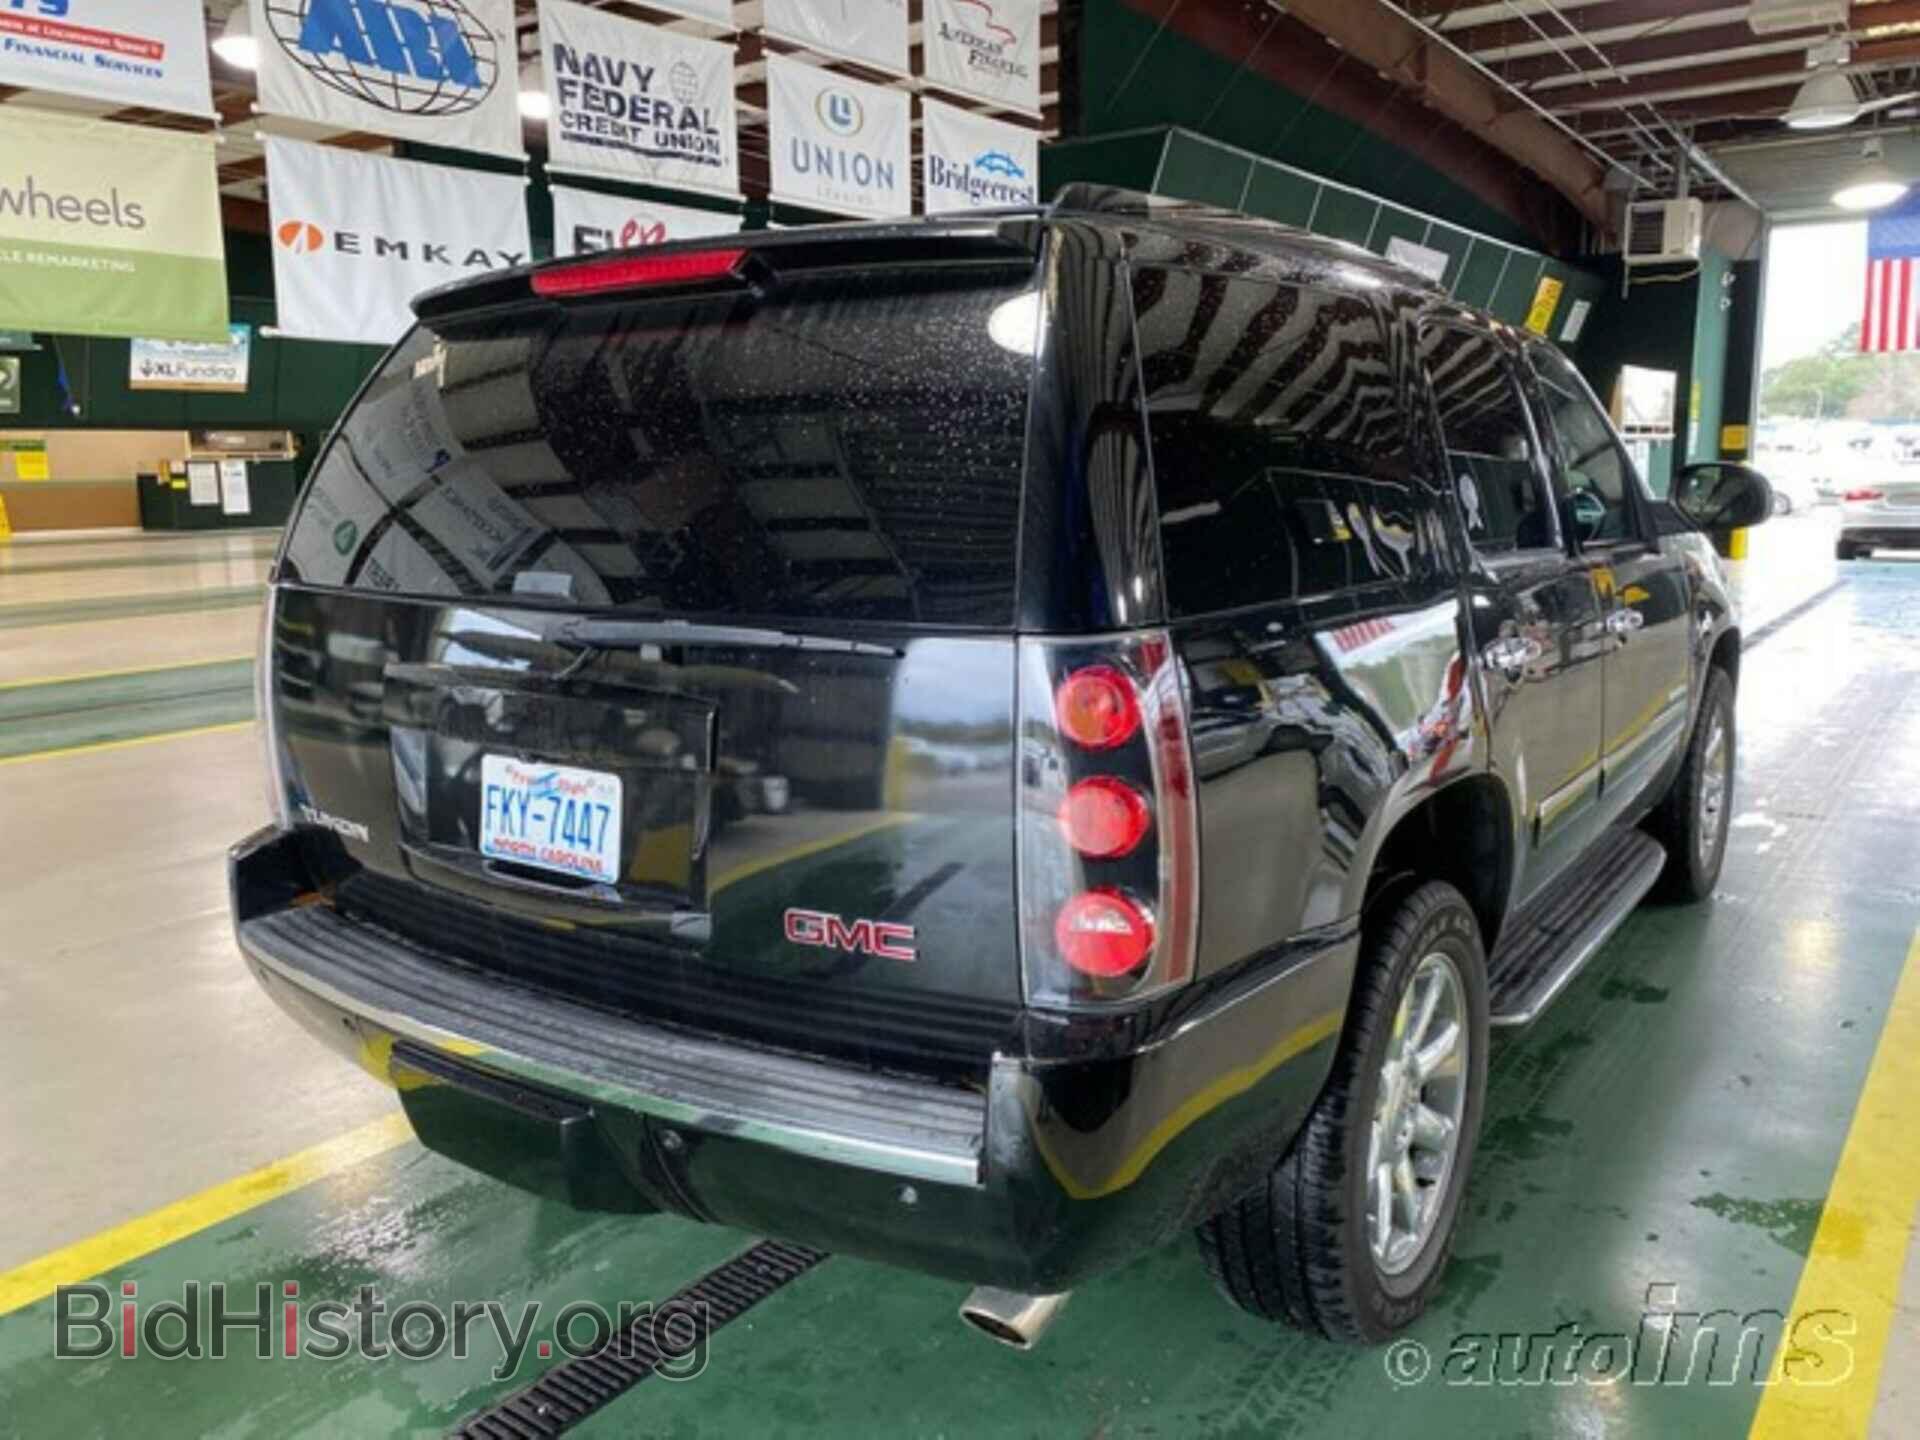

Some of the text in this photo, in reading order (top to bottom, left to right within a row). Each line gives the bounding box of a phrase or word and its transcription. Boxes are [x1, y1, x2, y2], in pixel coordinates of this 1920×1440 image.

[553, 43, 655, 93] NAVY
[557, 76, 720, 136] FEDERAL
[560, 110, 720, 155] CREDIT UNION
[792, 138, 894, 190] UNION
[0, 175, 146, 230] wheels
[333, 231, 525, 268] EMKAY
[485, 784, 611, 854] FKY-7447
[783, 908, 917, 962] GMC
